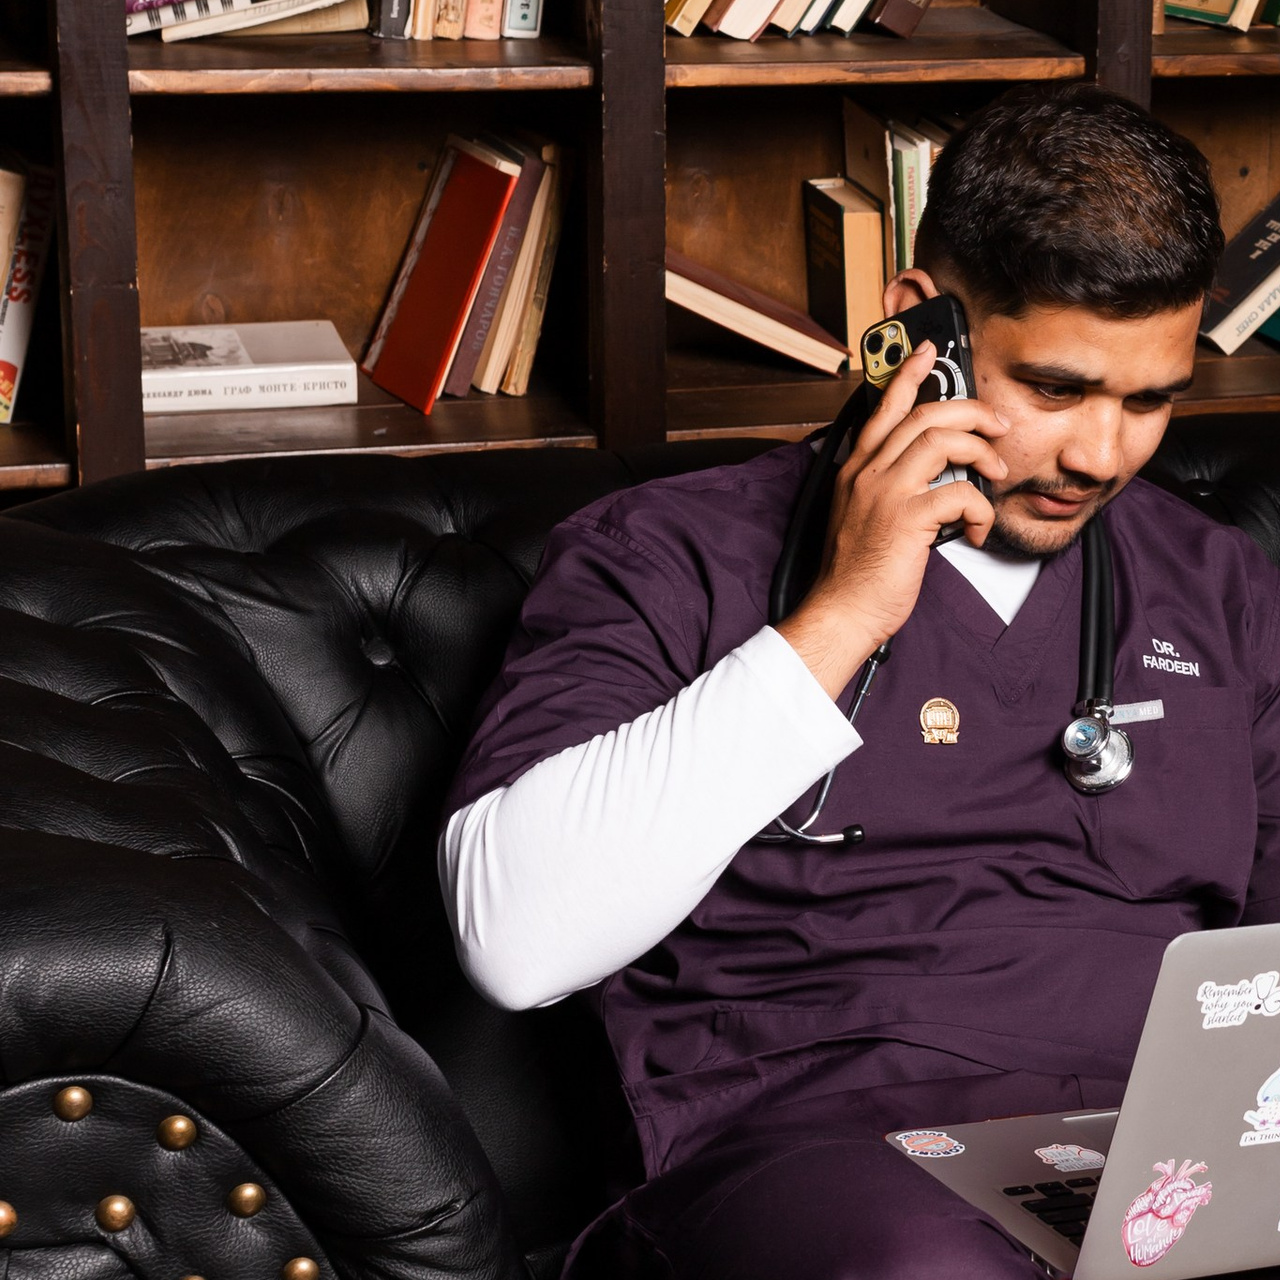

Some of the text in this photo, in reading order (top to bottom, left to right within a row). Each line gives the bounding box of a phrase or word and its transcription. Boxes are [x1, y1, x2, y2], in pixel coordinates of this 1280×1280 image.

[470, 262, 508, 352] ГОНЧАРОВ
[1230, 305, 1264, 340] СНЕГ
[187, 387, 213, 397] ДЮМА
[223, 384, 252, 396] ГРАФ
[1151, 638, 1181, 658] DR.
[1142, 655, 1200, 677] FARDEEN
[1201, 983, 1253, 999] Remember
[1205, 997, 1253, 1014] why you
[1207, 1009, 1245, 1026] started
[911, 1143, 964, 1157] CORONA
